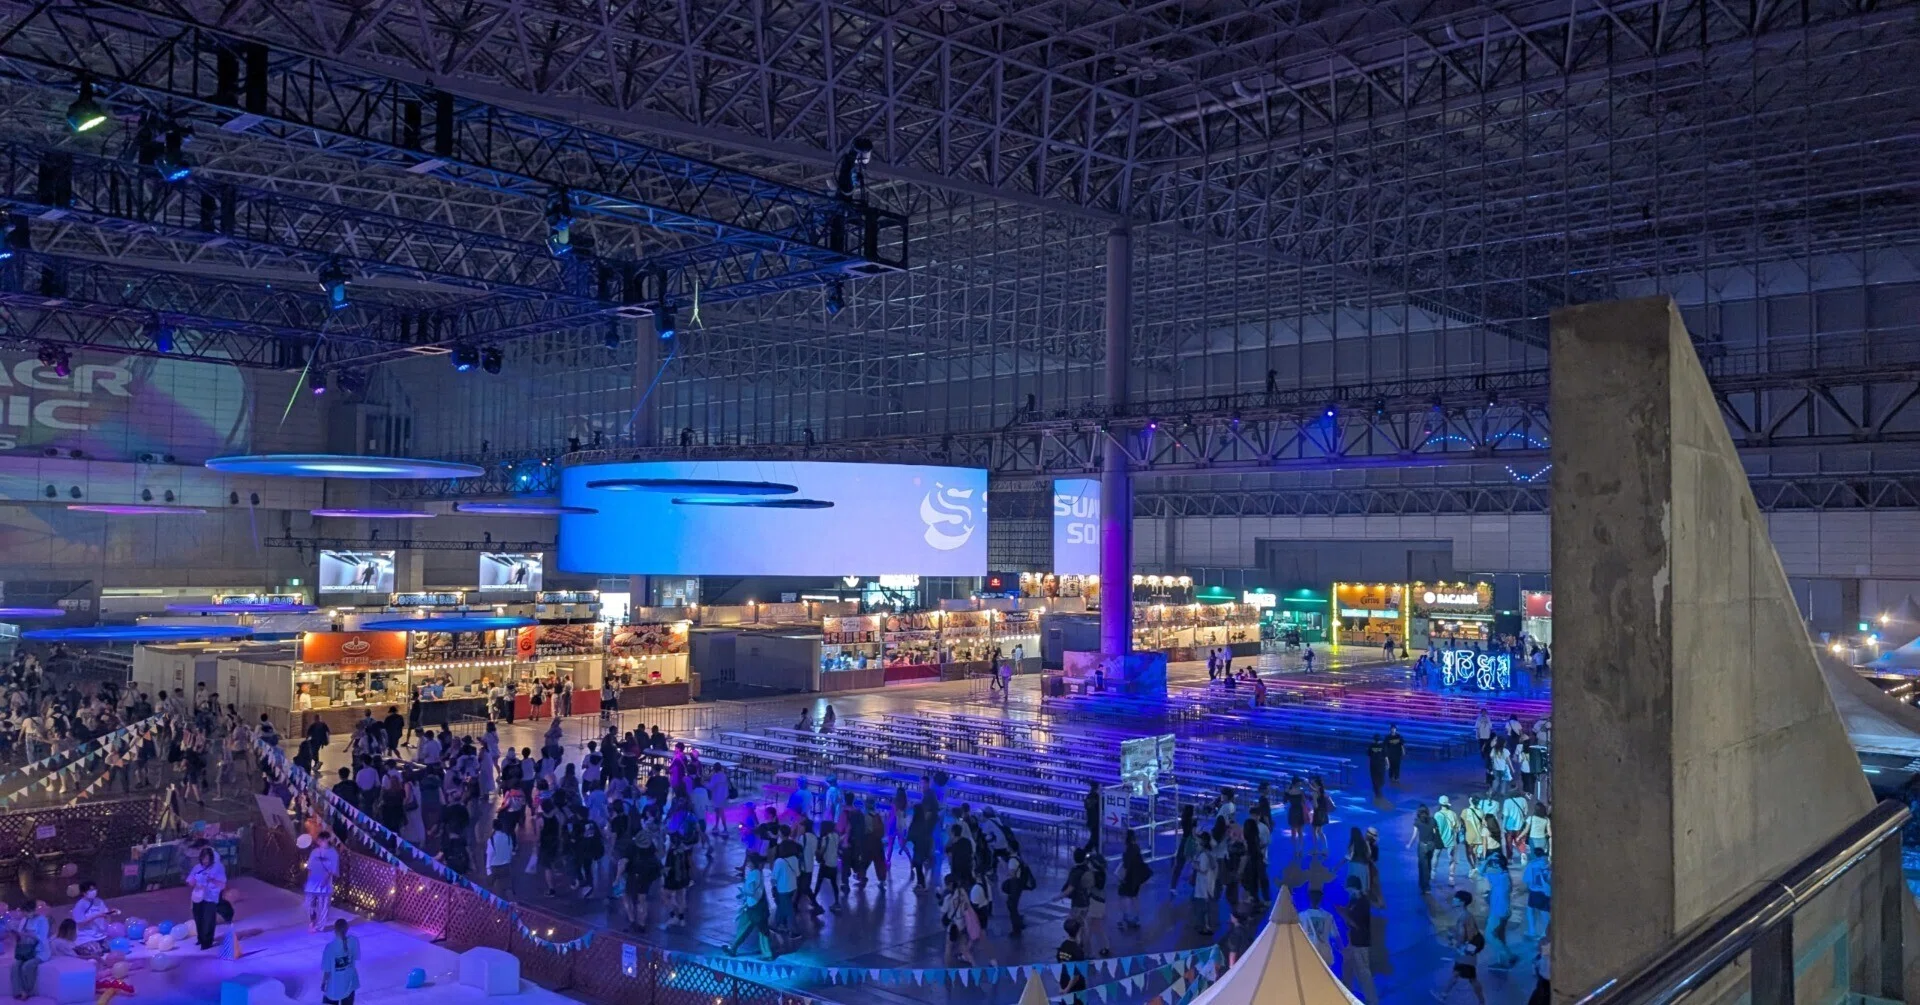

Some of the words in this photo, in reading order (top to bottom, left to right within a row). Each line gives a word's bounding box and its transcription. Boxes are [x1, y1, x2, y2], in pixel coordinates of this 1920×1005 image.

[0, 358, 133, 397] ER
[0, 395, 90, 431] IC
[1066, 522, 1100, 545] SO
[398, 594, 438, 605] OFFICIAL
[439, 594, 456, 605] BAR
[1106, 794, 1126, 807] 出口
